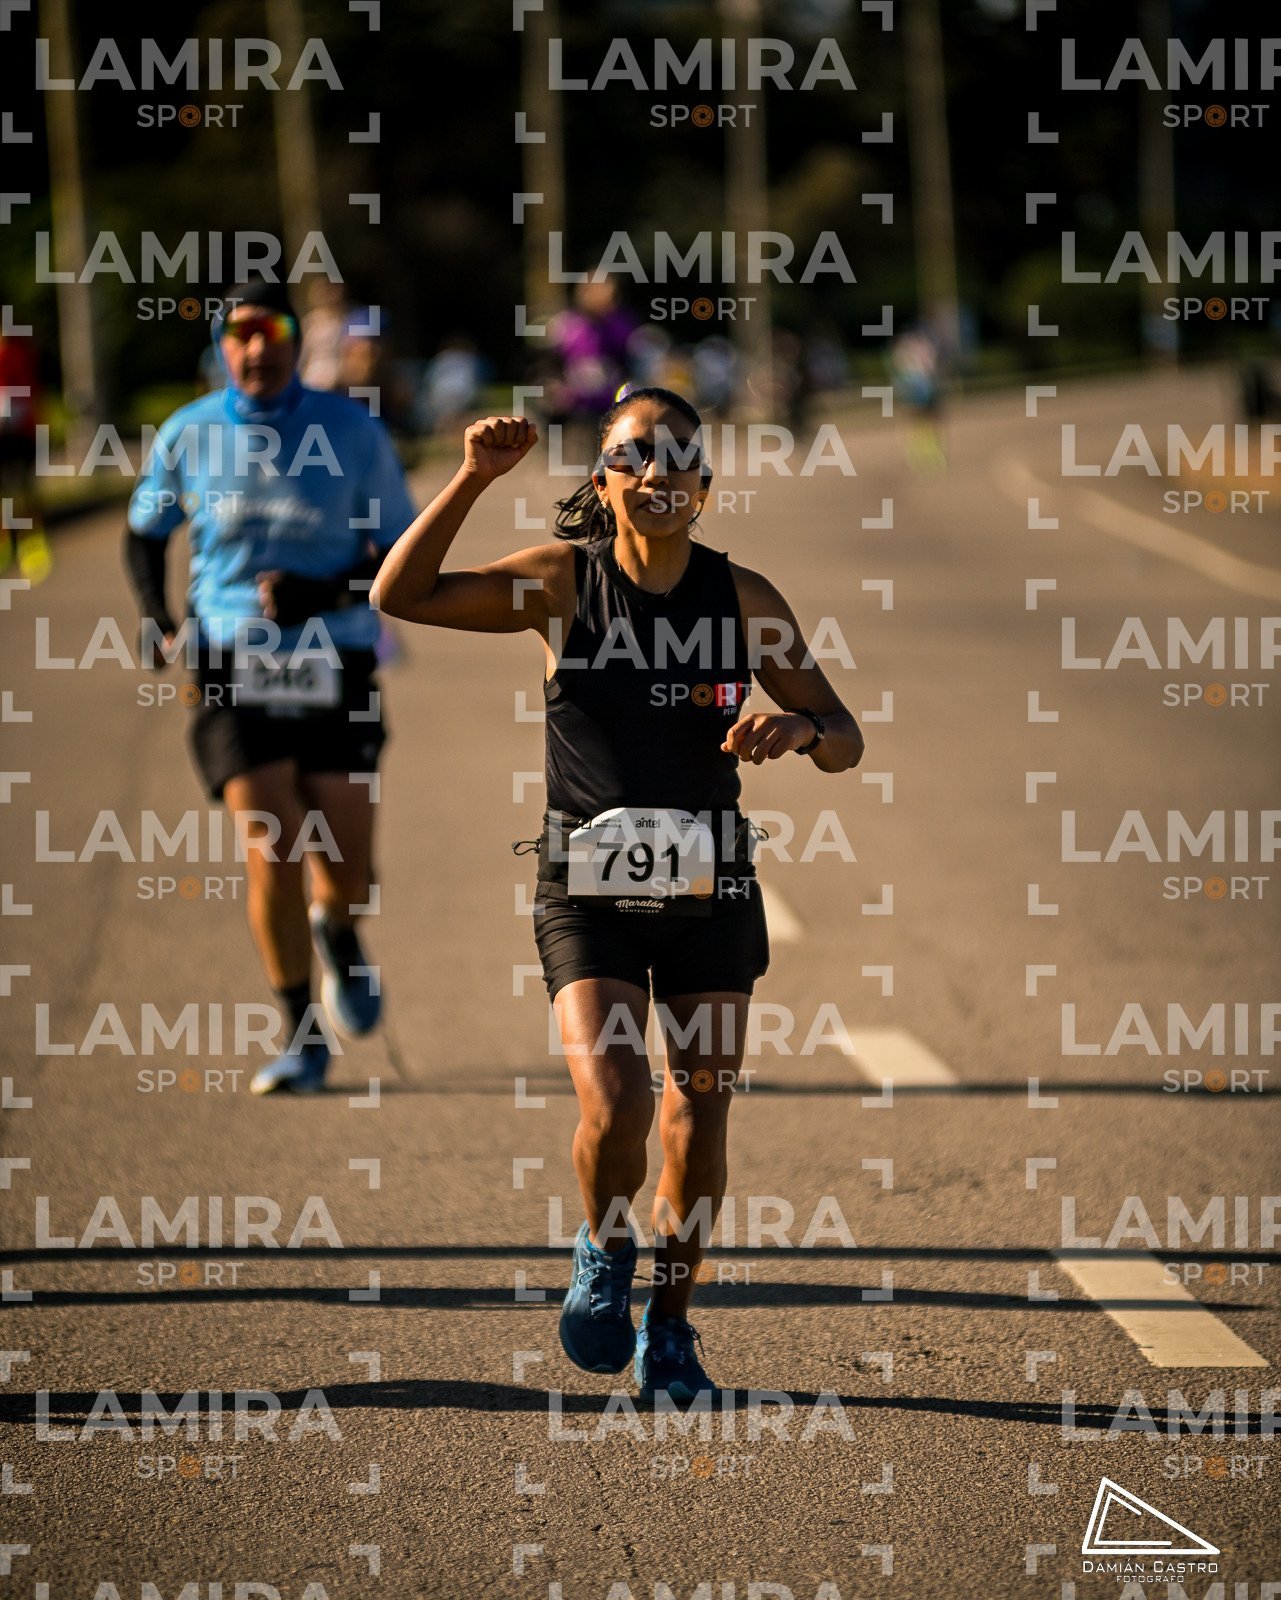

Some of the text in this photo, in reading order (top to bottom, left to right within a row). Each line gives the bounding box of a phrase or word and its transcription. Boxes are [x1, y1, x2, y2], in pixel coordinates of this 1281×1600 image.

[635, 816, 661, 829] antel
[596, 842, 680, 882] 791
[615, 899, 665, 909] Maratón
